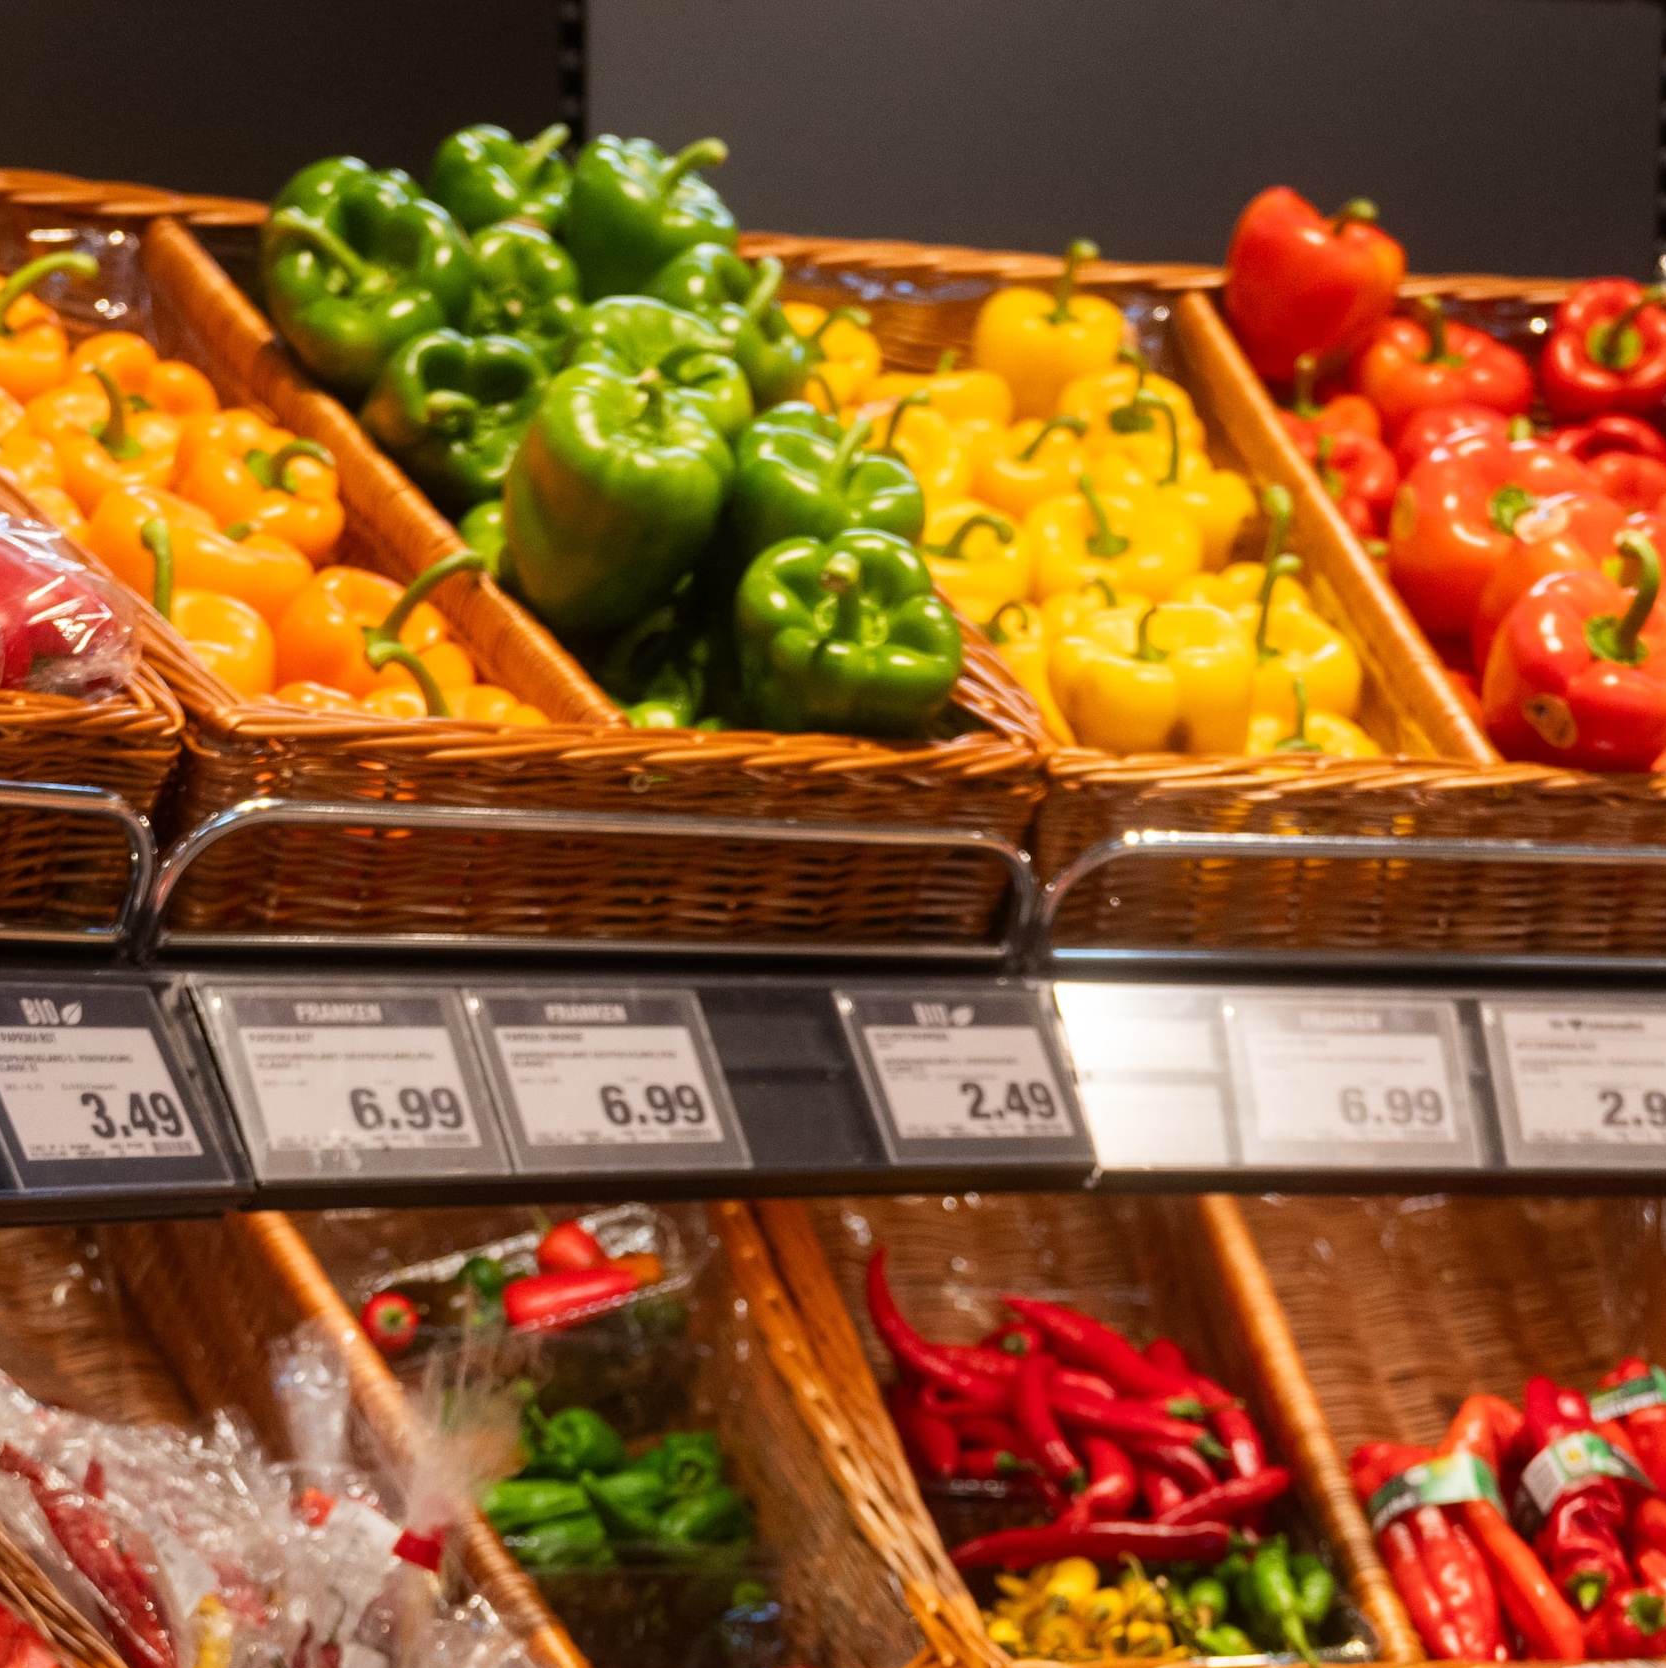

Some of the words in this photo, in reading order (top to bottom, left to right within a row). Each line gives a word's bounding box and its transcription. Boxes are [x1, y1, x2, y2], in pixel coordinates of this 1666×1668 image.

[20, 998, 61, 1025] BIO
[81, 1091, 185, 1139] 3.49
[349, 1087, 466, 1131] 6.99
[599, 1084, 706, 1127] 6.99
[959, 1081, 1057, 1121] 2.49
[1338, 1086, 1445, 1127] 6.99
